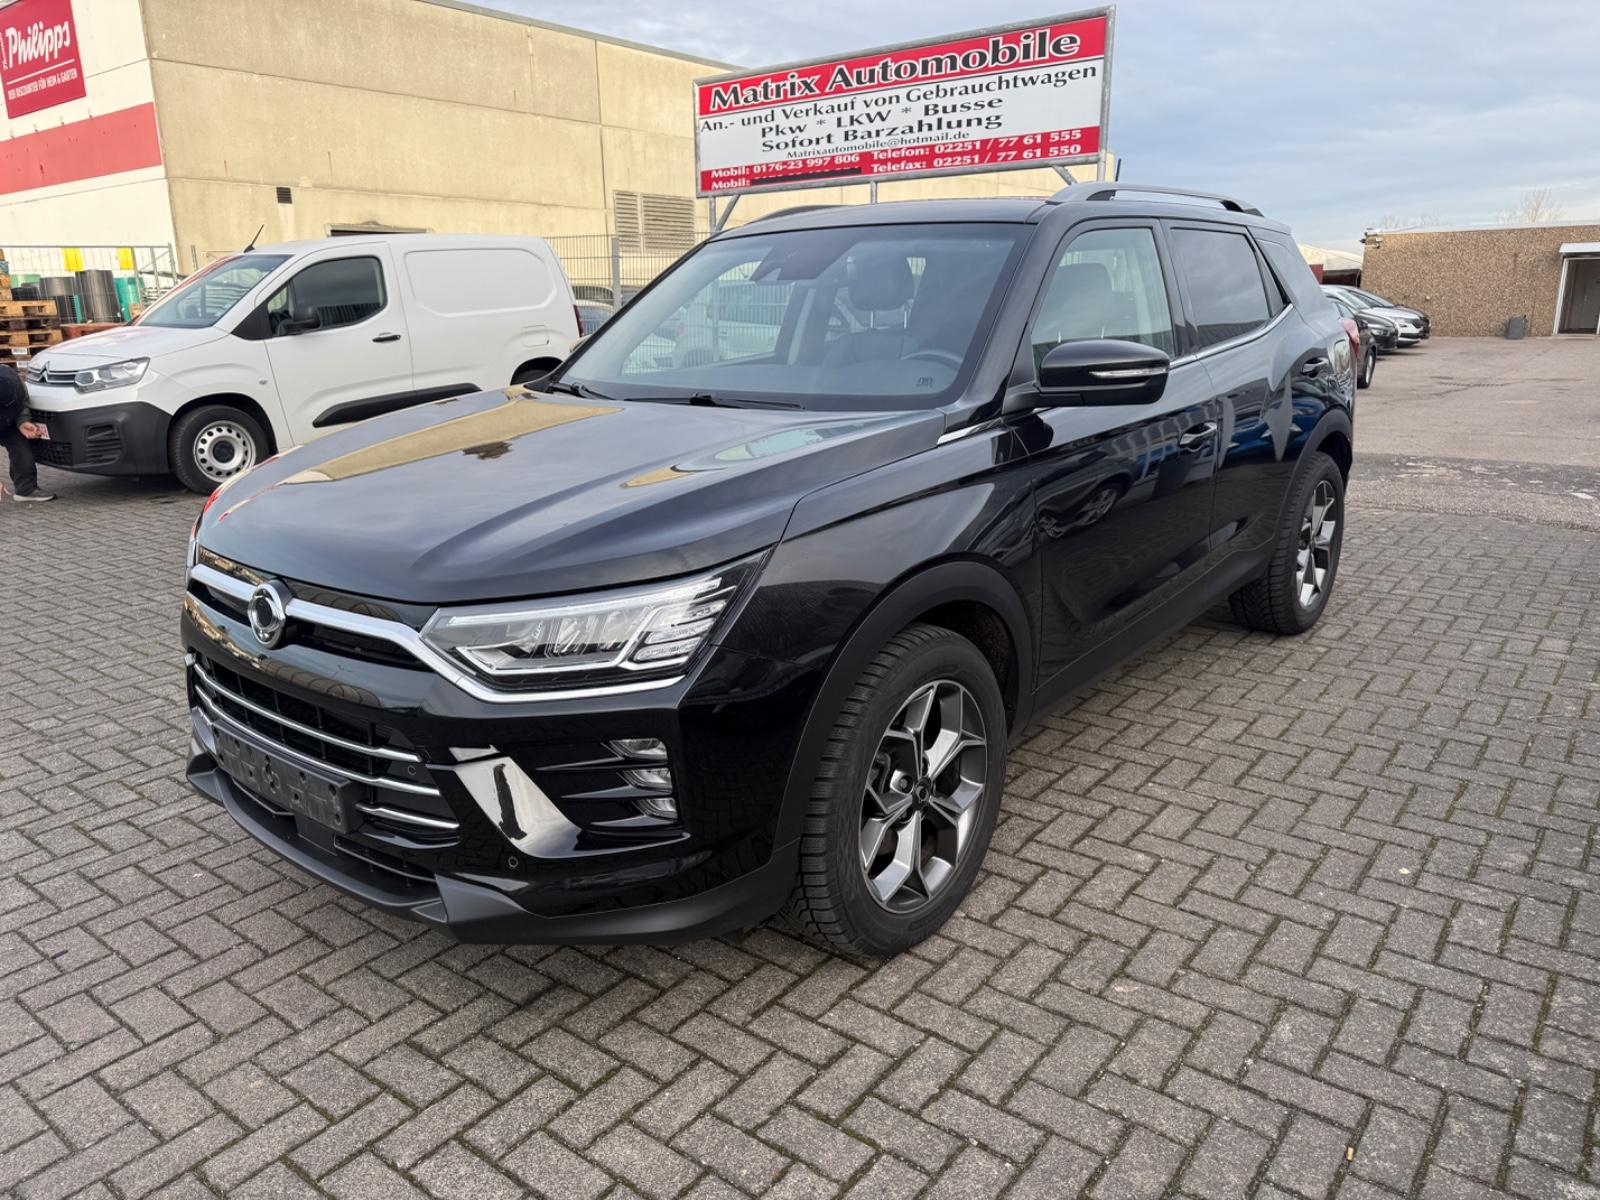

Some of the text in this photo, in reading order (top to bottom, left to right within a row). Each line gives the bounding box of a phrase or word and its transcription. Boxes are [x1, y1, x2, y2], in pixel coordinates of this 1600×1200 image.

[5, 21, 71, 68] Philipps
[709, 29, 1080, 111] Matrix Automobile
[741, 110, 775, 126] und
[782, 97, 857, 119] Verkauf
[864, 93, 900, 108] von
[906, 66, 1097, 102] Gebrauchtwagen
[761, 97, 1003, 138] Pkw LKW Busse
[762, 114, 1003, 152] Sofort Barzahlung
[787, 131, 969, 159] Matrixautomobile@hotmail.de
[871, 130, 1082, 160] Telefon: 02251 / 77 61 555
[871, 144, 1082, 173] Telefax: 02251 / 77 61 550
[711, 166, 749, 179] Mobil:
[753, 160, 803, 173] 0176-23
[806, 156, 830, 167] 997
[834, 153, 860, 164] 806
[711, 178, 749, 190] Mobil:
